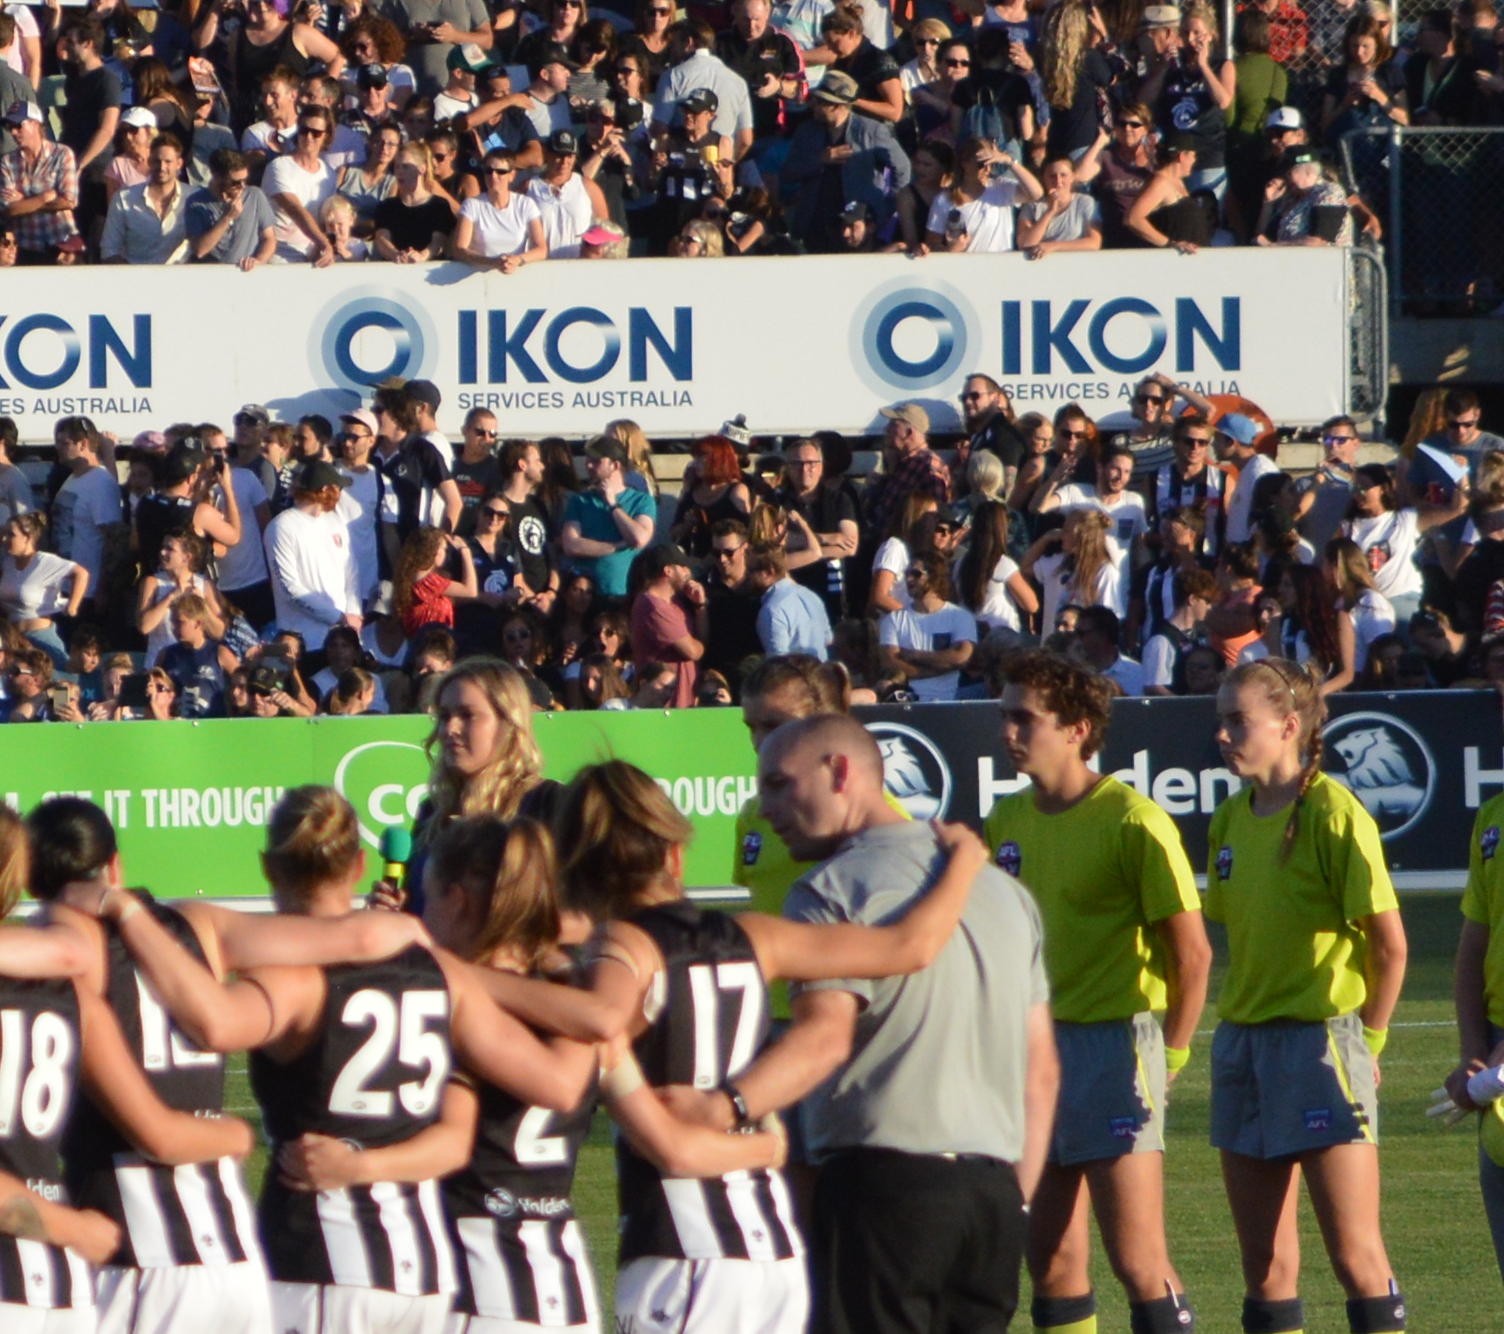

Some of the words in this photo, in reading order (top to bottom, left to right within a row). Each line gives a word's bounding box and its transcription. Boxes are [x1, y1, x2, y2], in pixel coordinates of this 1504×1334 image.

[458, 306, 692, 384] IKON
[1001, 296, 1241, 375] IKON
[32, 396, 153, 414] AUSTRALIA
[458, 392, 564, 409] SERVICES
[572, 390, 693, 407] AUSTRALIA
[1006, 382, 1110, 400] SERVICES
[328, 988, 451, 1118] 25
[688, 962, 768, 1090] 17
